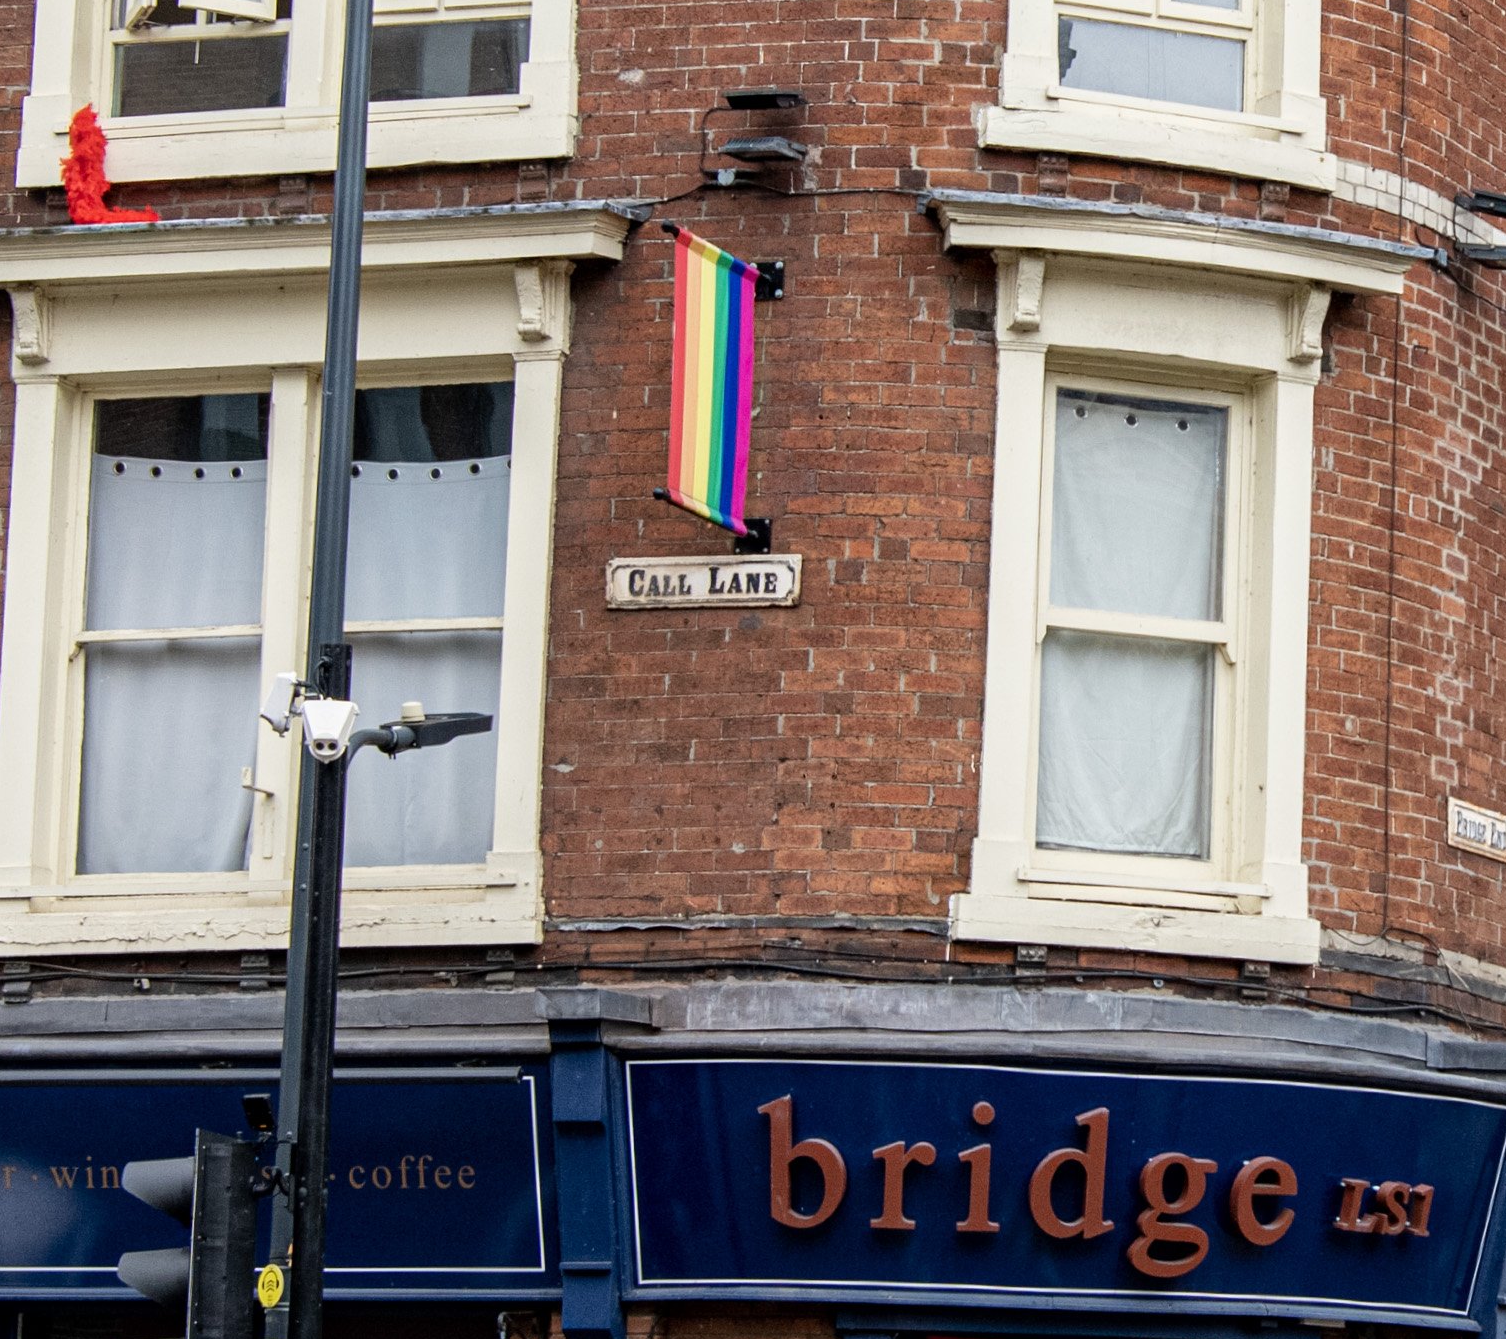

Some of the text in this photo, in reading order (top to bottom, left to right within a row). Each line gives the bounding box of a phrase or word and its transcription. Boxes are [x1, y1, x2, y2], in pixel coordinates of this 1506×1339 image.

[628, 566, 778, 597] CALL LANE
[348, 1154, 477, 1190] coffee
[756, 1092, 1437, 1279] bridge LS1
